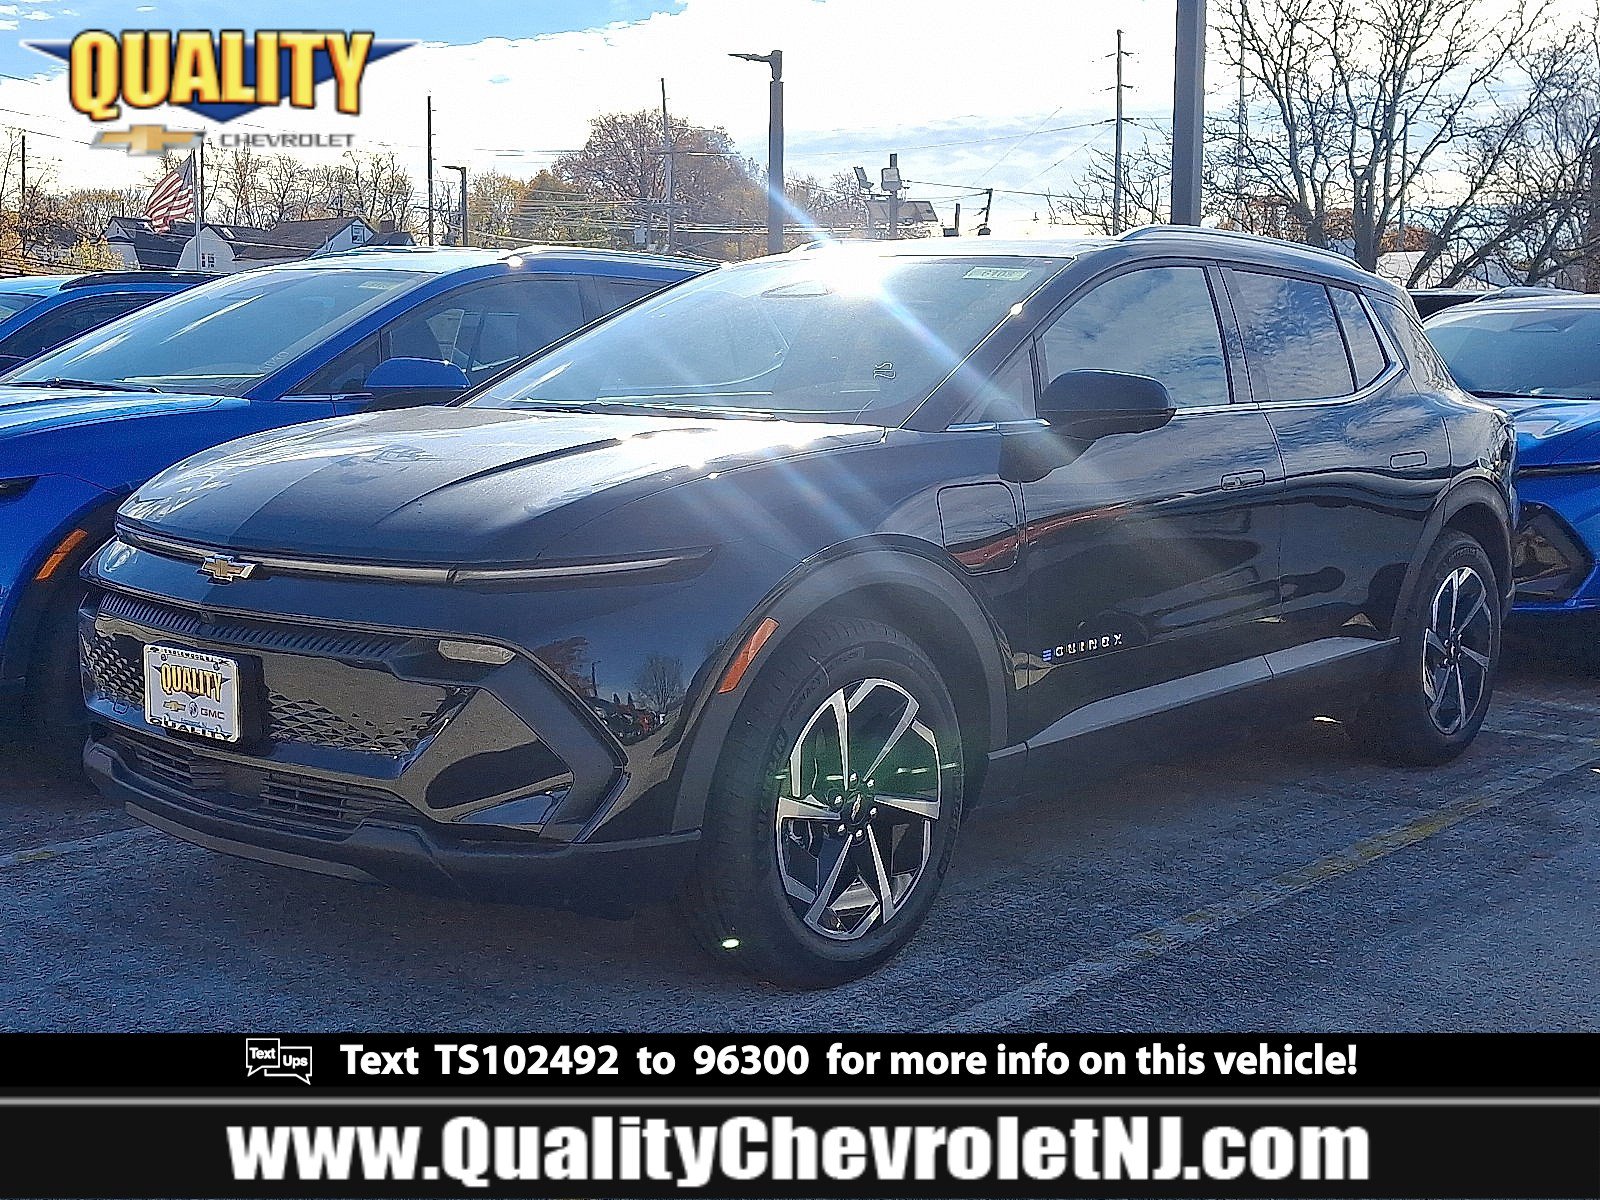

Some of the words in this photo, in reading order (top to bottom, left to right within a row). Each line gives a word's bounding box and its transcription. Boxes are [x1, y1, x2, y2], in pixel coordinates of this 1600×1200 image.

[1042, 633, 1123, 662] EQUINOX
[160, 662, 223, 703] QUALITY
[201, 707, 225, 720] GMC
